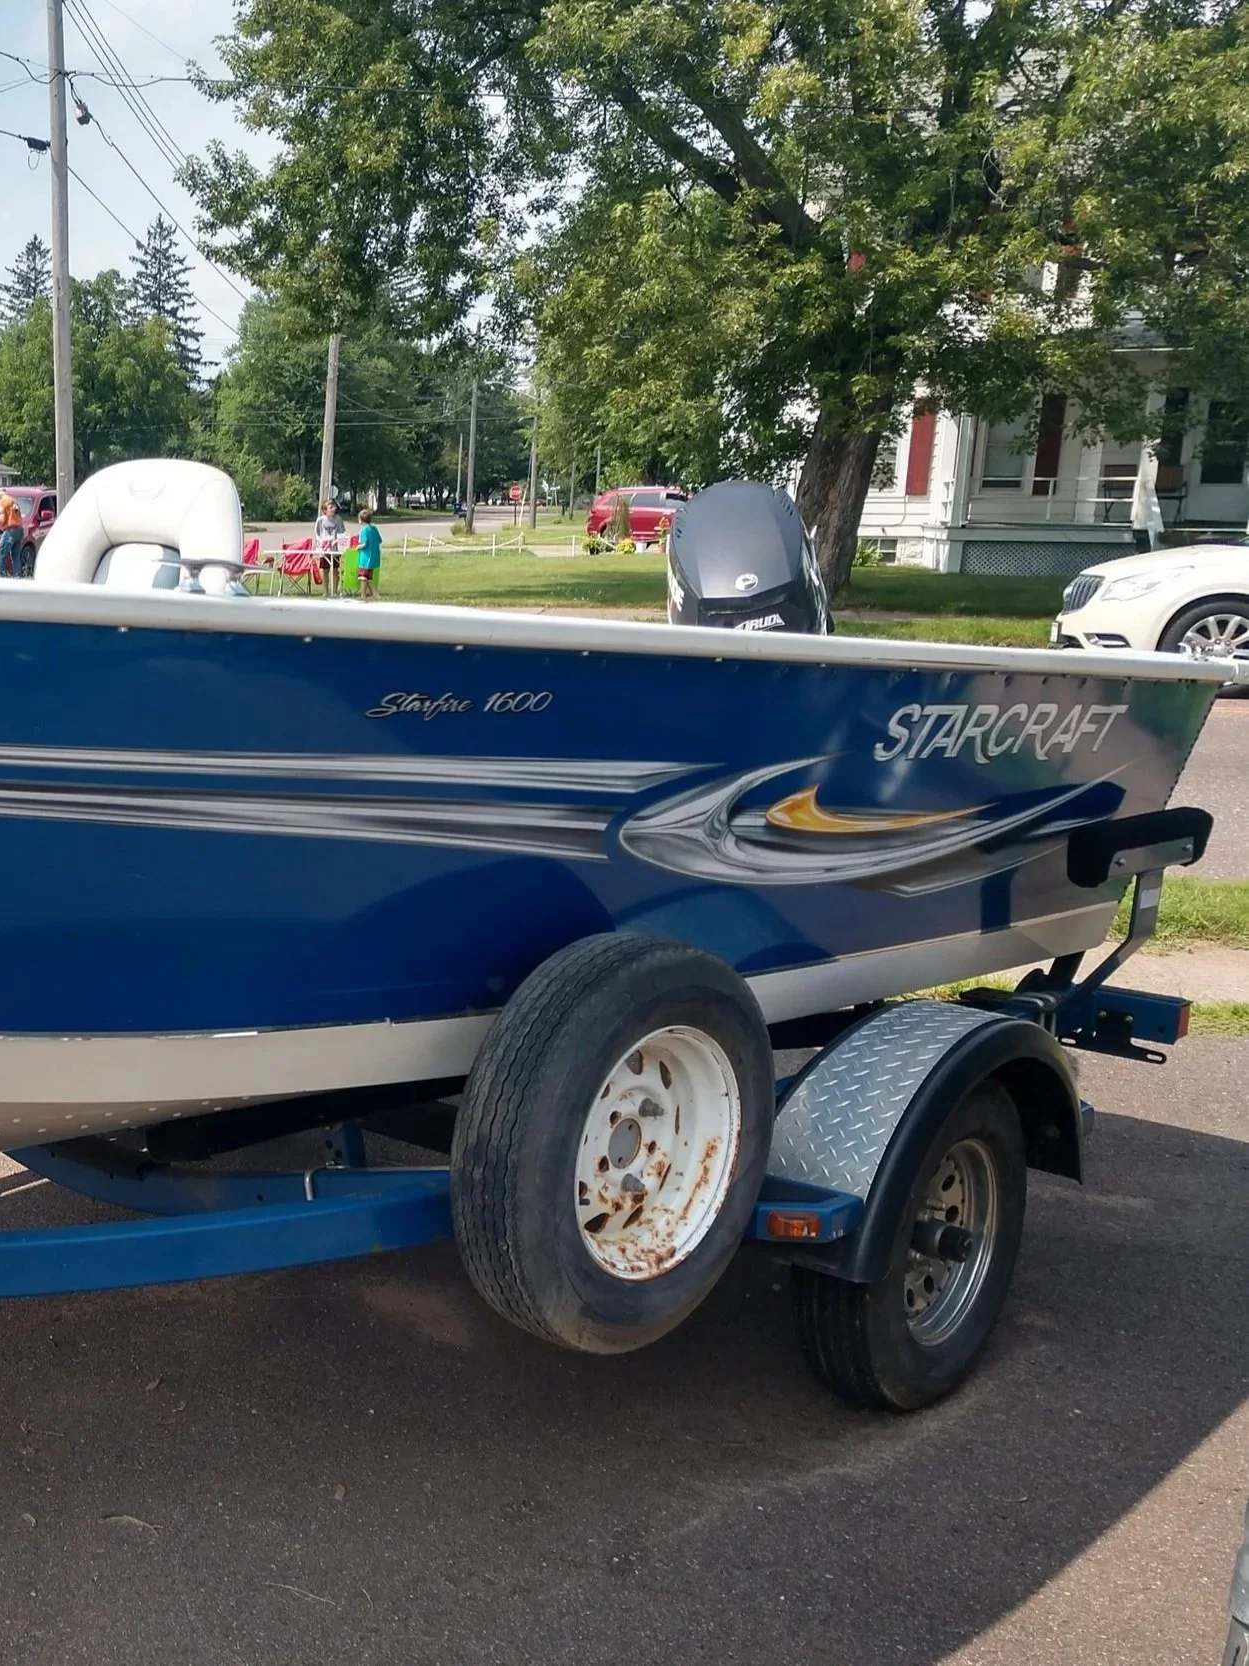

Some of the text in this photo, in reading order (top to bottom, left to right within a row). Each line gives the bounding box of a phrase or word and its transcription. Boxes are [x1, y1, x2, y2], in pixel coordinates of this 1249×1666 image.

[365, 691, 553, 721] Starfire 1600
[873, 703, 1129, 764] STARCRAFT
